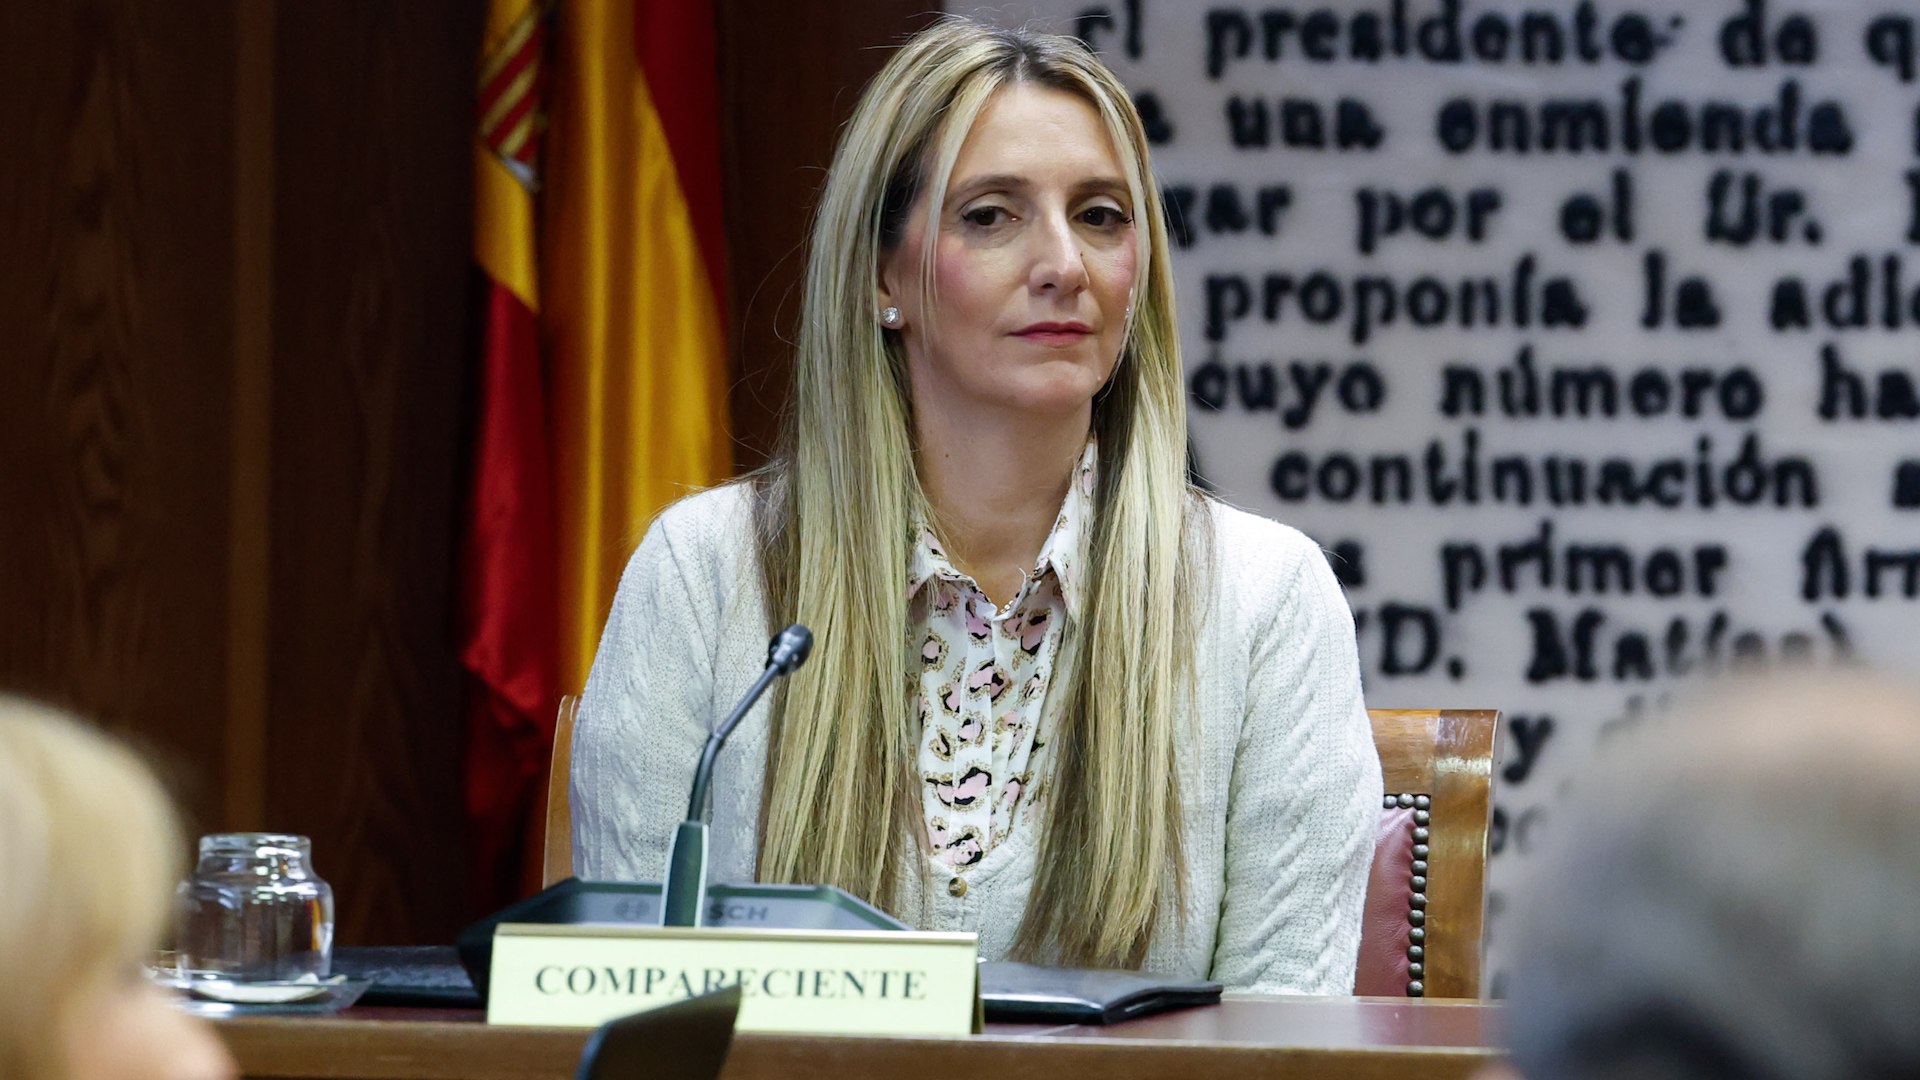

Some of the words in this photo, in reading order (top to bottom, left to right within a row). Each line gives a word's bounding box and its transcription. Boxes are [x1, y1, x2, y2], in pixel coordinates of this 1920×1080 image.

[1224, 96, 1384, 148] una
[1355, 186, 1501, 254] por
[1560, 166, 1633, 244] el
[1640, 250, 1720, 330] la
[1191, 360, 1384, 430] cuyo
[1442, 343, 1763, 422] número
[1441, 519, 1727, 613] primer
[535, 964, 928, 1000] COMPARECIENTE
